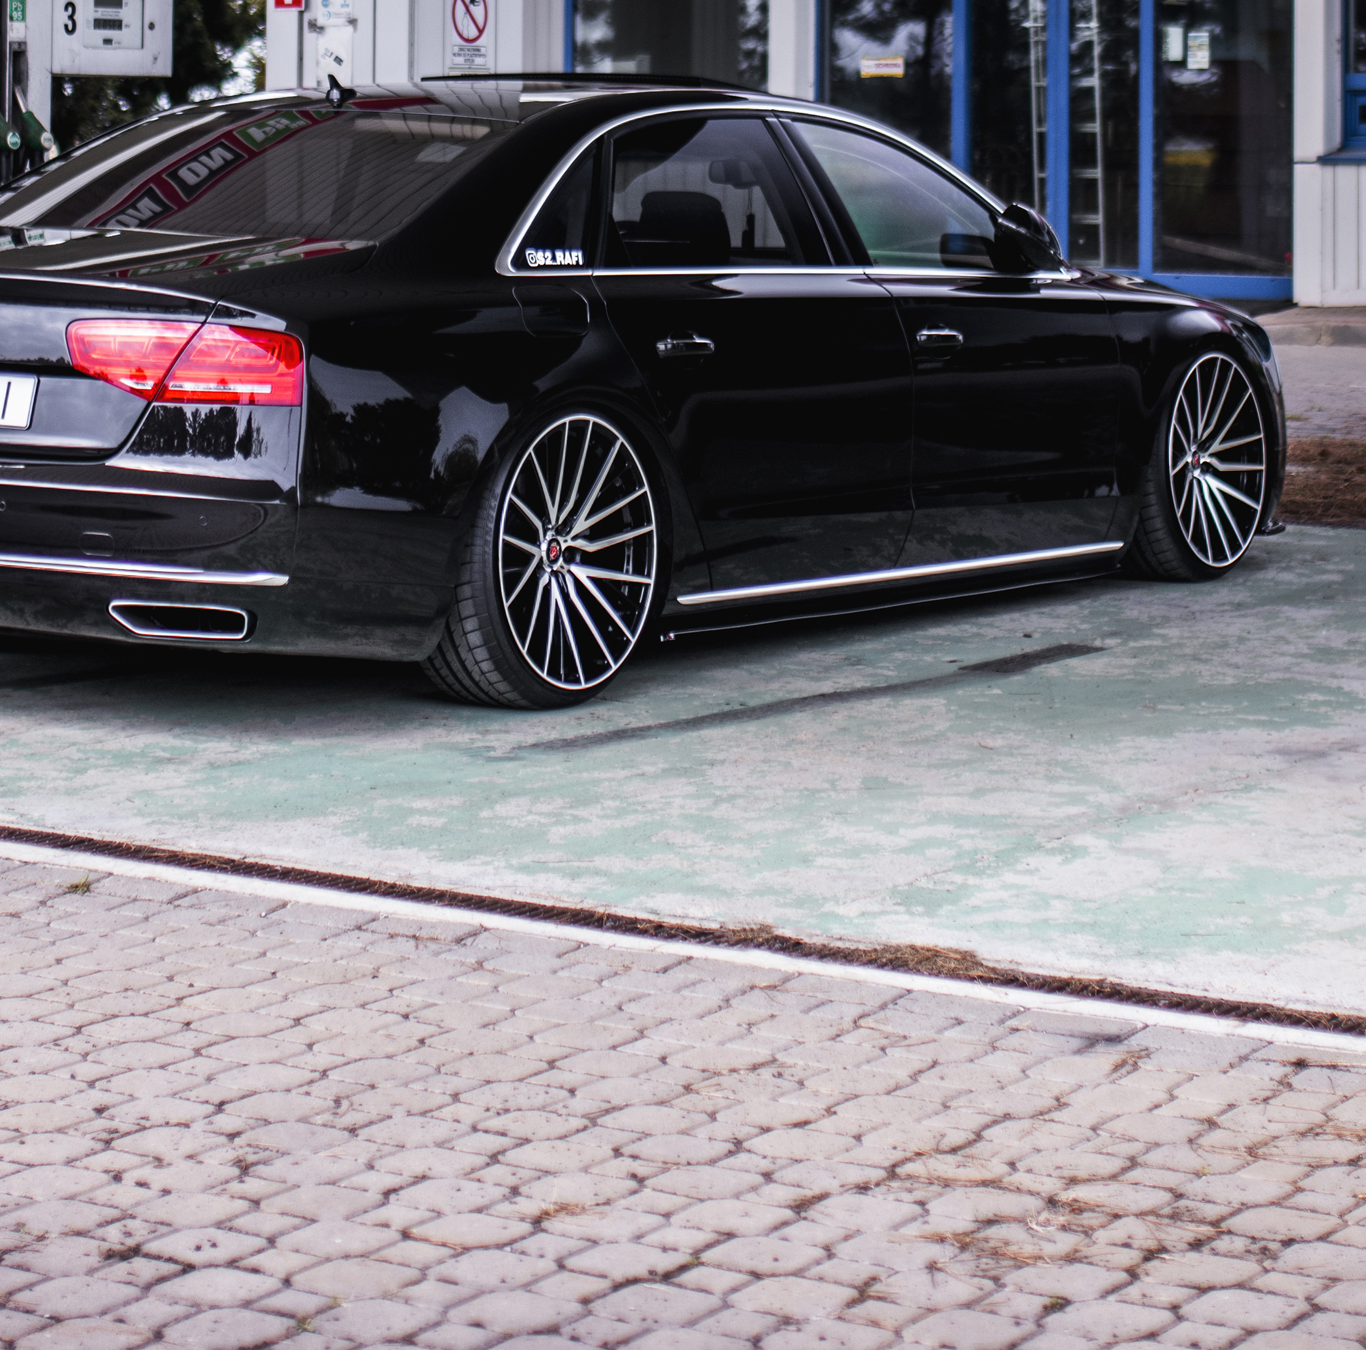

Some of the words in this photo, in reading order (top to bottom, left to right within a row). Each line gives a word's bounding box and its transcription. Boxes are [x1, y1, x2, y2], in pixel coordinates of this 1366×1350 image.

[11, 1, 23, 11] Pb
[11, 11, 23, 21] 95
[63, 1, 77, 36] 3
